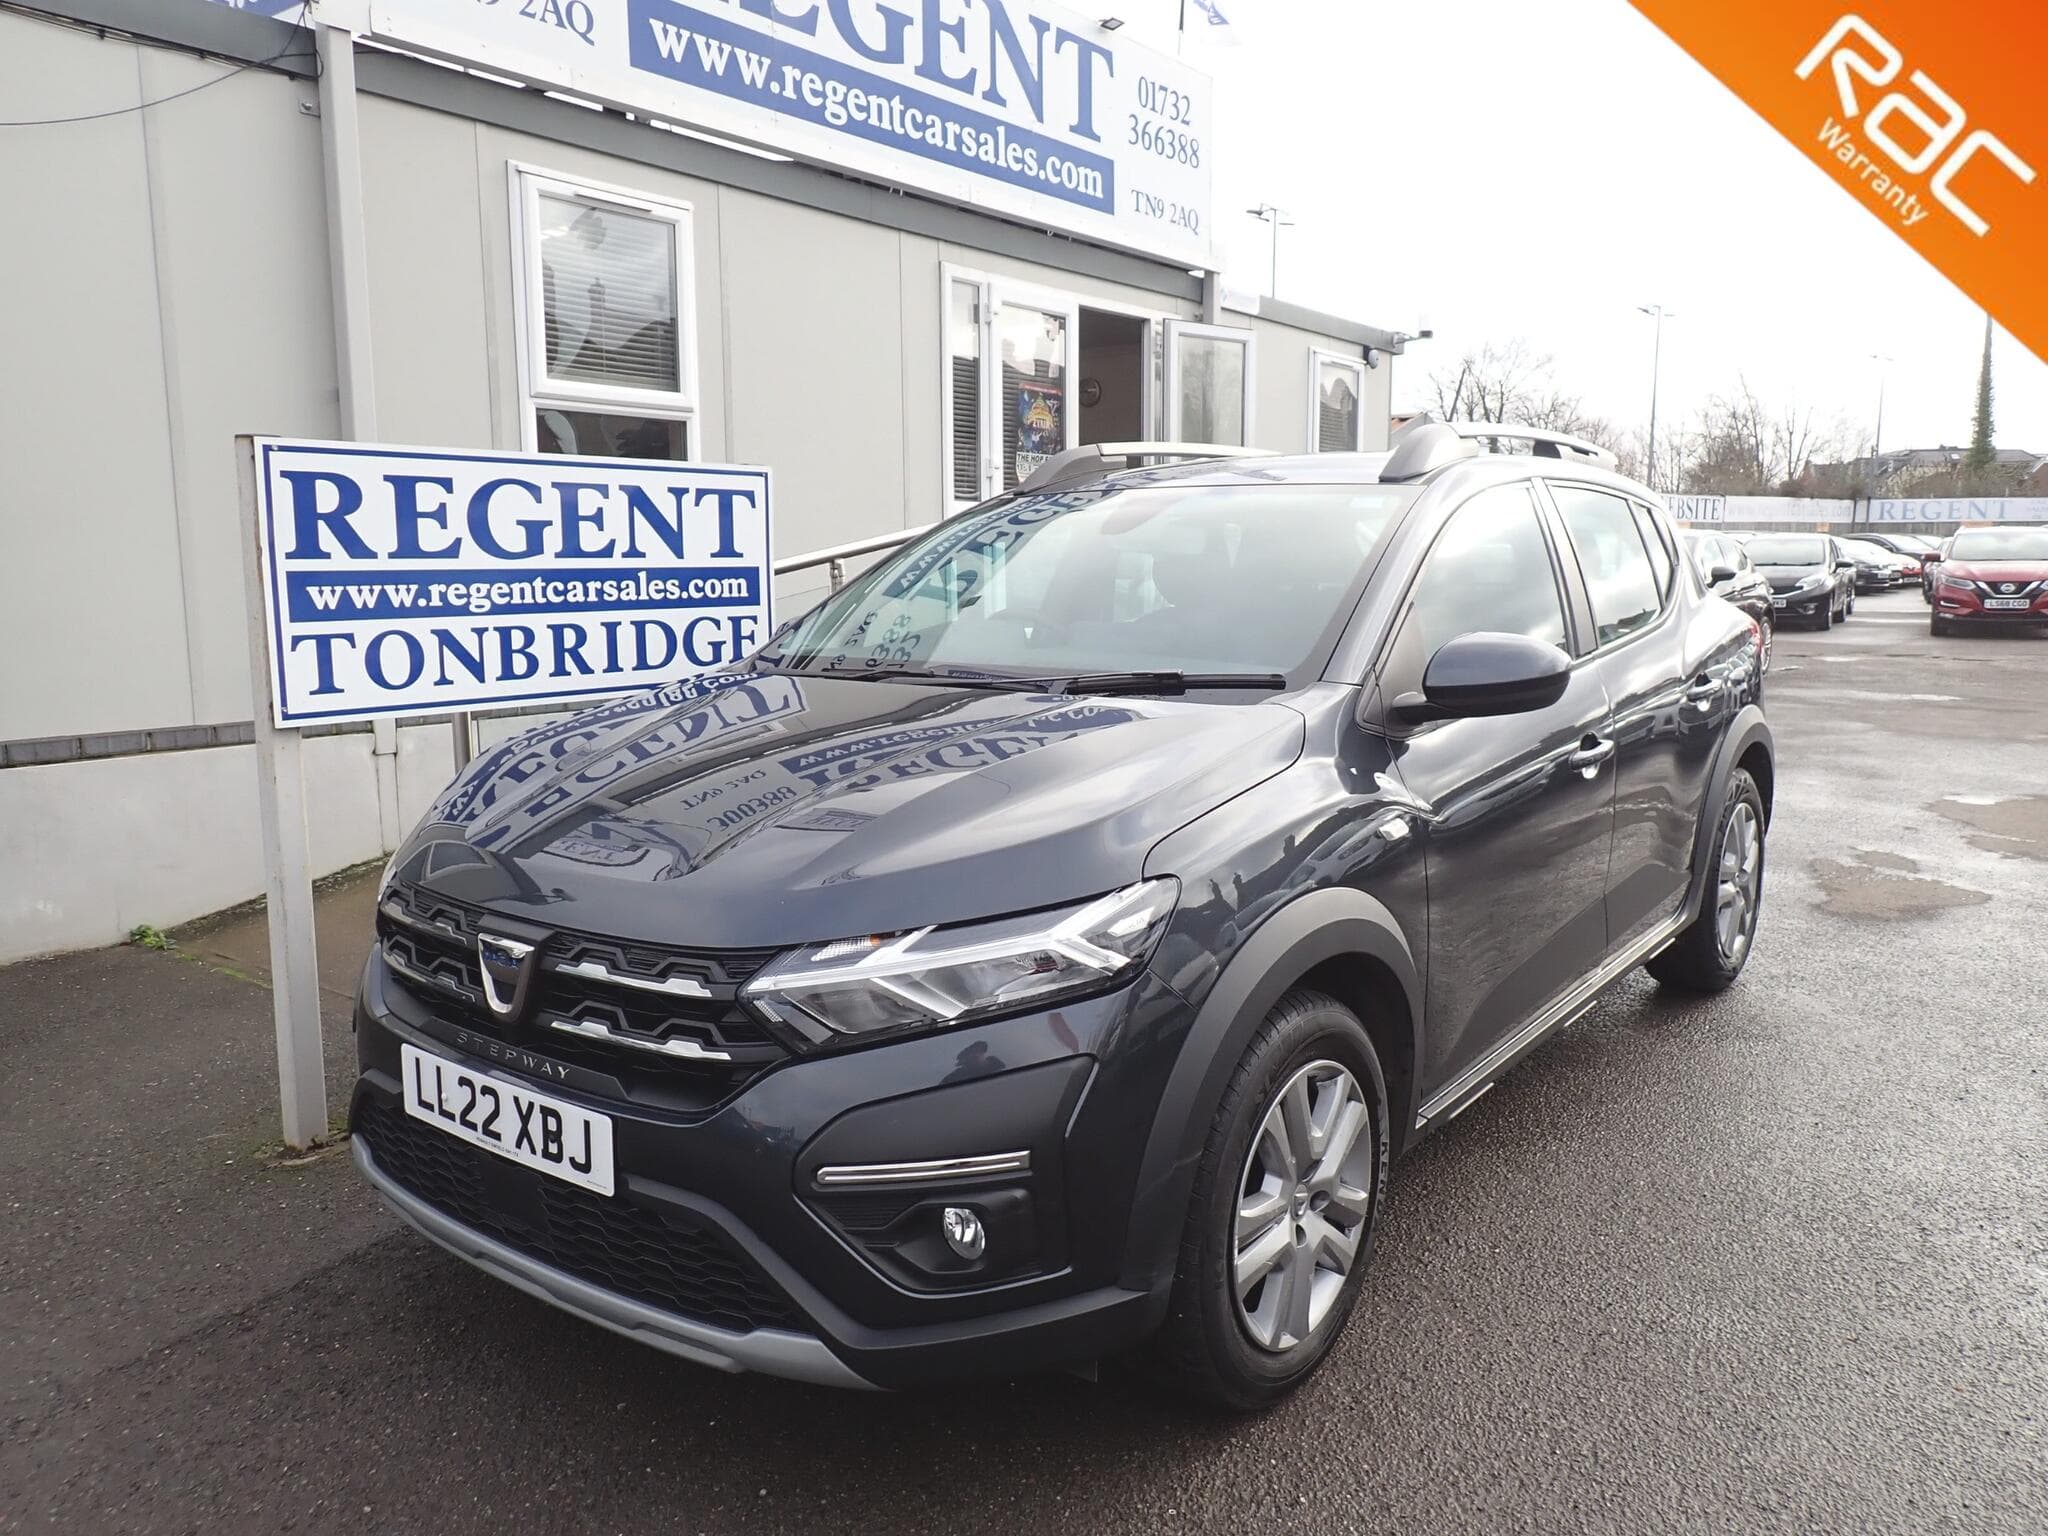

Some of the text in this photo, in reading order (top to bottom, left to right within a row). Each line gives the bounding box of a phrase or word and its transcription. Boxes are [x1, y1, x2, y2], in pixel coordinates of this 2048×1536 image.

[648, 17, 1104, 199] www.regentcarsales.com
[1137, 76, 1192, 127] 01732
[1128, 114, 1200, 169] 366388
[1131, 189, 1199, 236] TN9 2AQ
[280, 470, 756, 561] REGENT
[1878, 501, 2014, 520] REGENT
[306, 571, 749, 613] www.regentcarsales.com
[291, 615, 759, 696] TONBRIDGE
[457, 1032, 570, 1080] STEPWAY
[415, 1056, 593, 1176] LL22 XBJ
